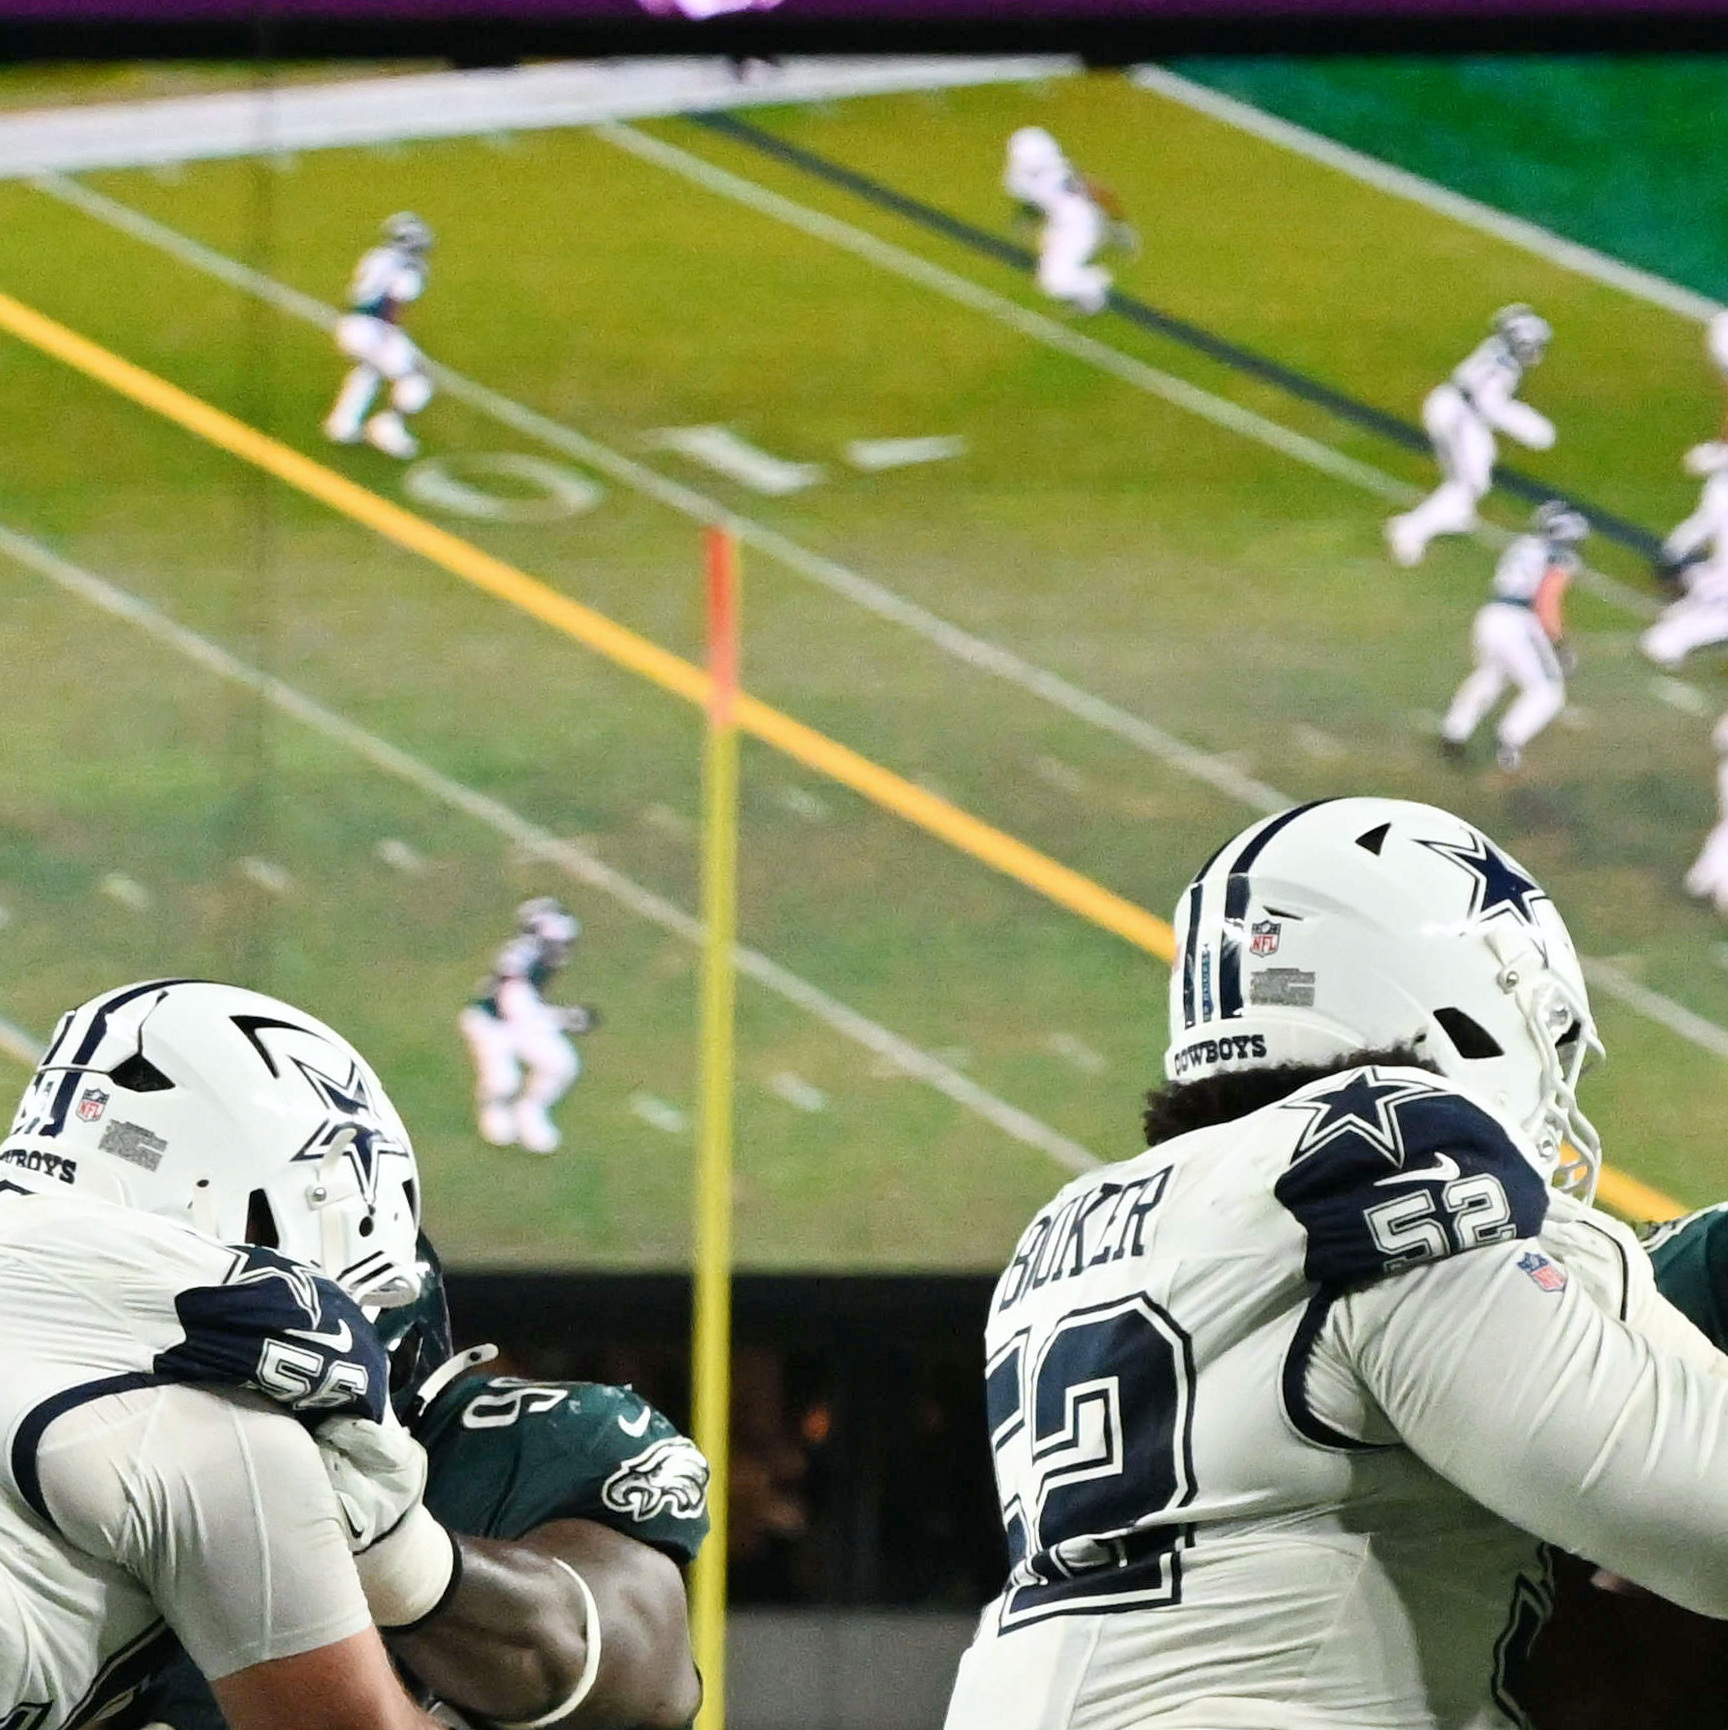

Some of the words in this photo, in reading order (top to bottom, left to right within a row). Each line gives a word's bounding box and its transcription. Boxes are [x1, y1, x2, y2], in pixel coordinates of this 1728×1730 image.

[1174, 1033, 1268, 1077] COWBOYS
[1363, 1173, 1517, 1274] 52
[255, 1338, 371, 1411] 56
